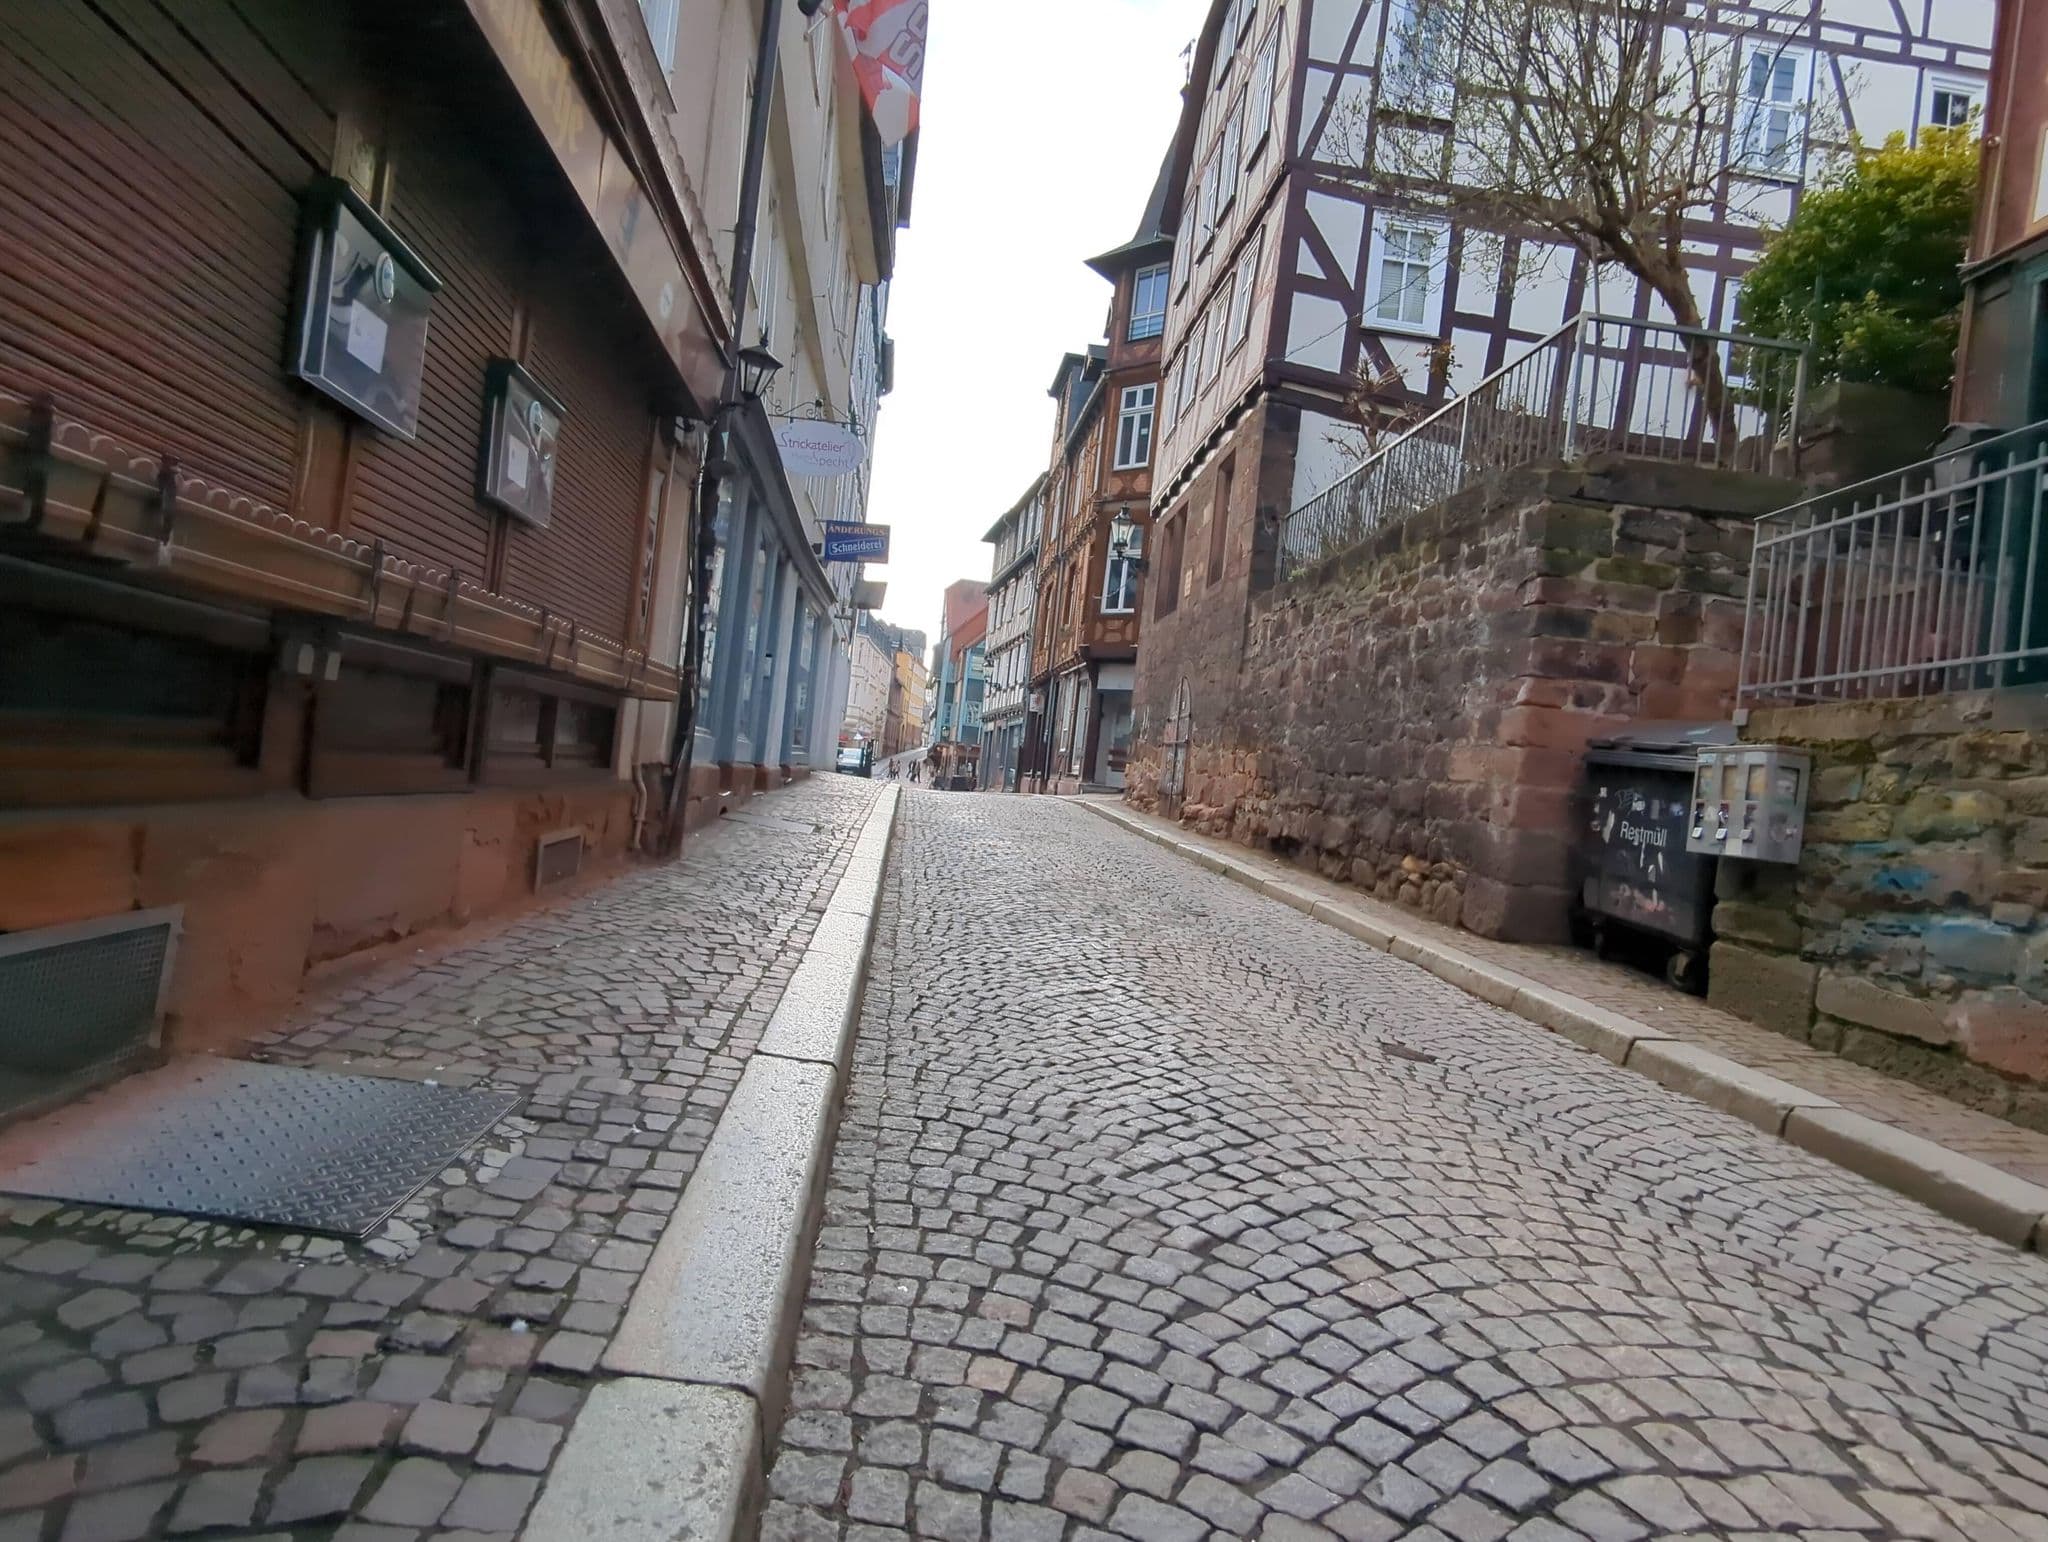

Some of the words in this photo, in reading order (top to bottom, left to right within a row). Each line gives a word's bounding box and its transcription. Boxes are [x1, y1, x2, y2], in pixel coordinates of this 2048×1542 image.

[777, 431, 845, 453] Strickatelier
[831, 538, 882, 553] Schneiderei
[1620, 821, 1667, 847] Restmüll
